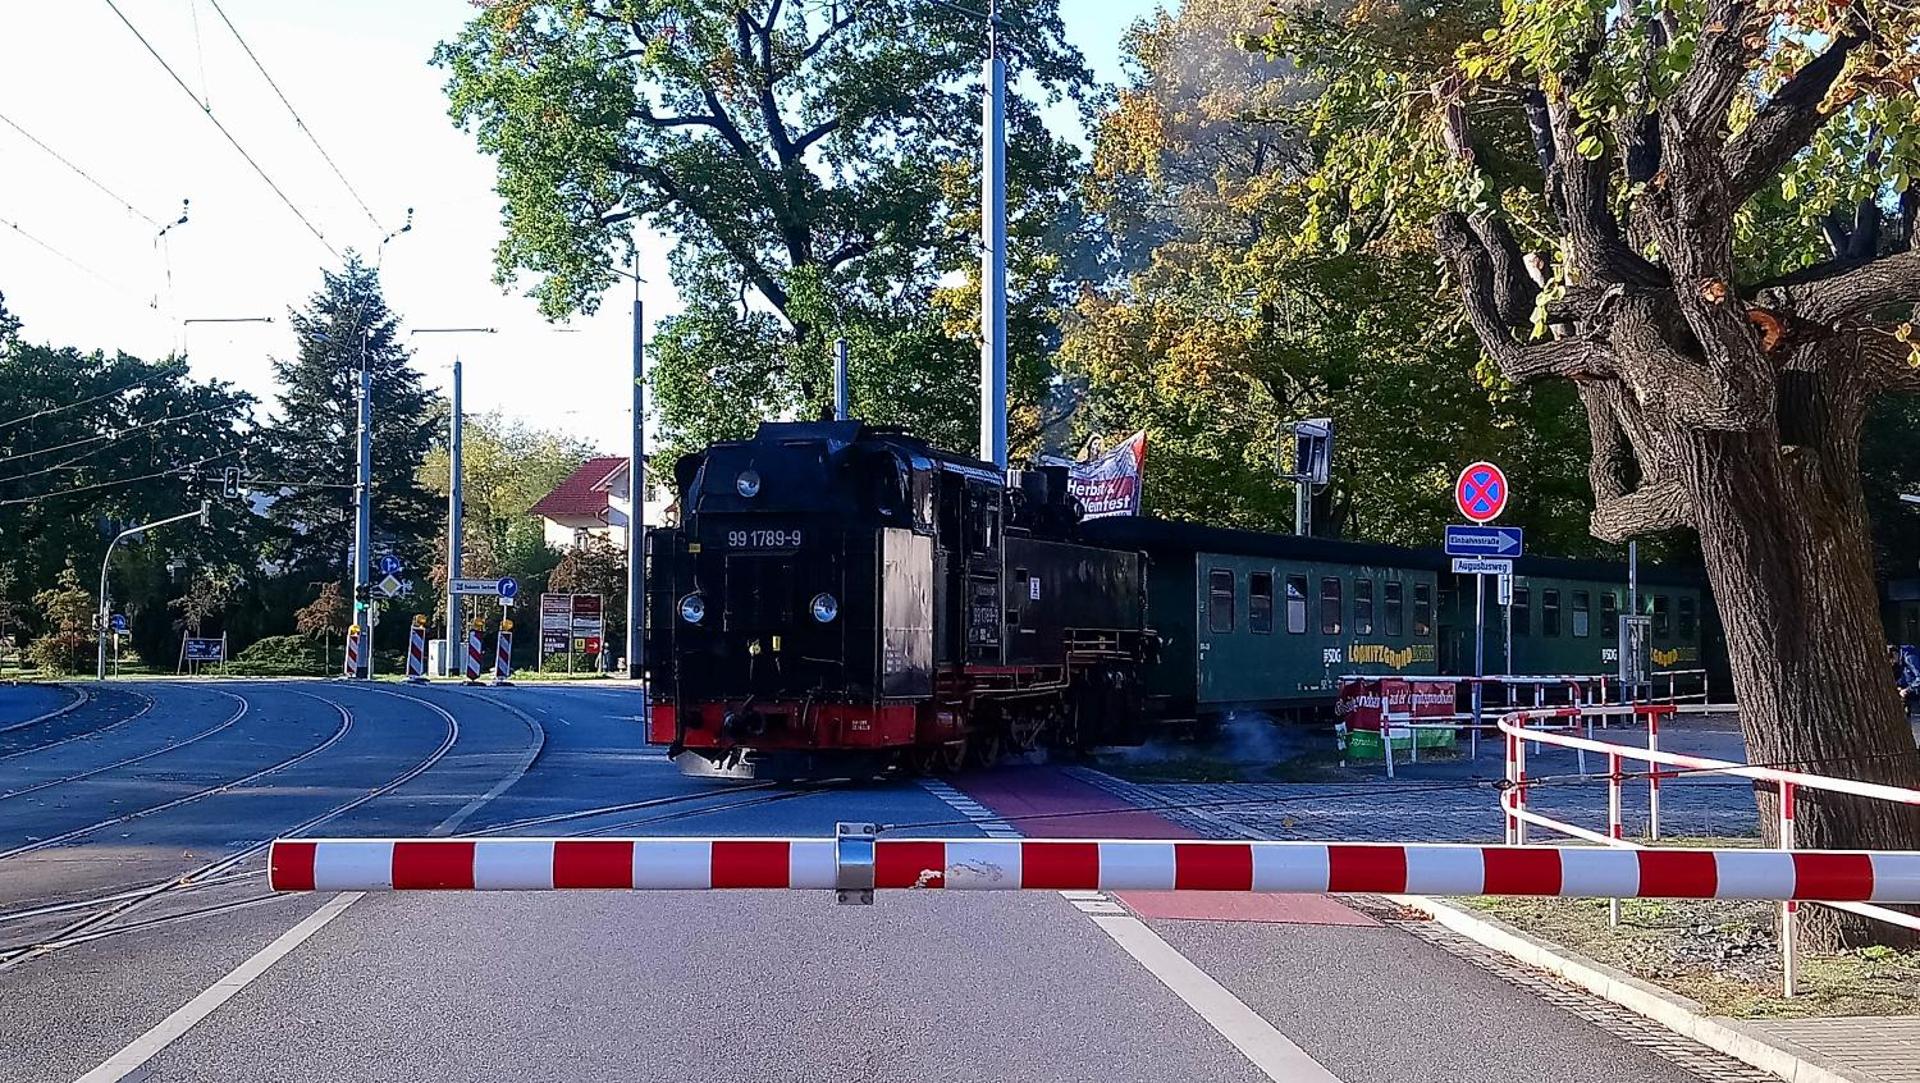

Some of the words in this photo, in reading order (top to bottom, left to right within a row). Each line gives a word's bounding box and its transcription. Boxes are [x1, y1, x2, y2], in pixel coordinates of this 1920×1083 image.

[1067, 479, 1107, 497] Herbst
[728, 530, 747, 546] 99
[750, 529, 802, 546] 1789-9
[1451, 536, 1500, 546] Einbahnstraße
[1457, 560, 1508, 573] Augustusweg
